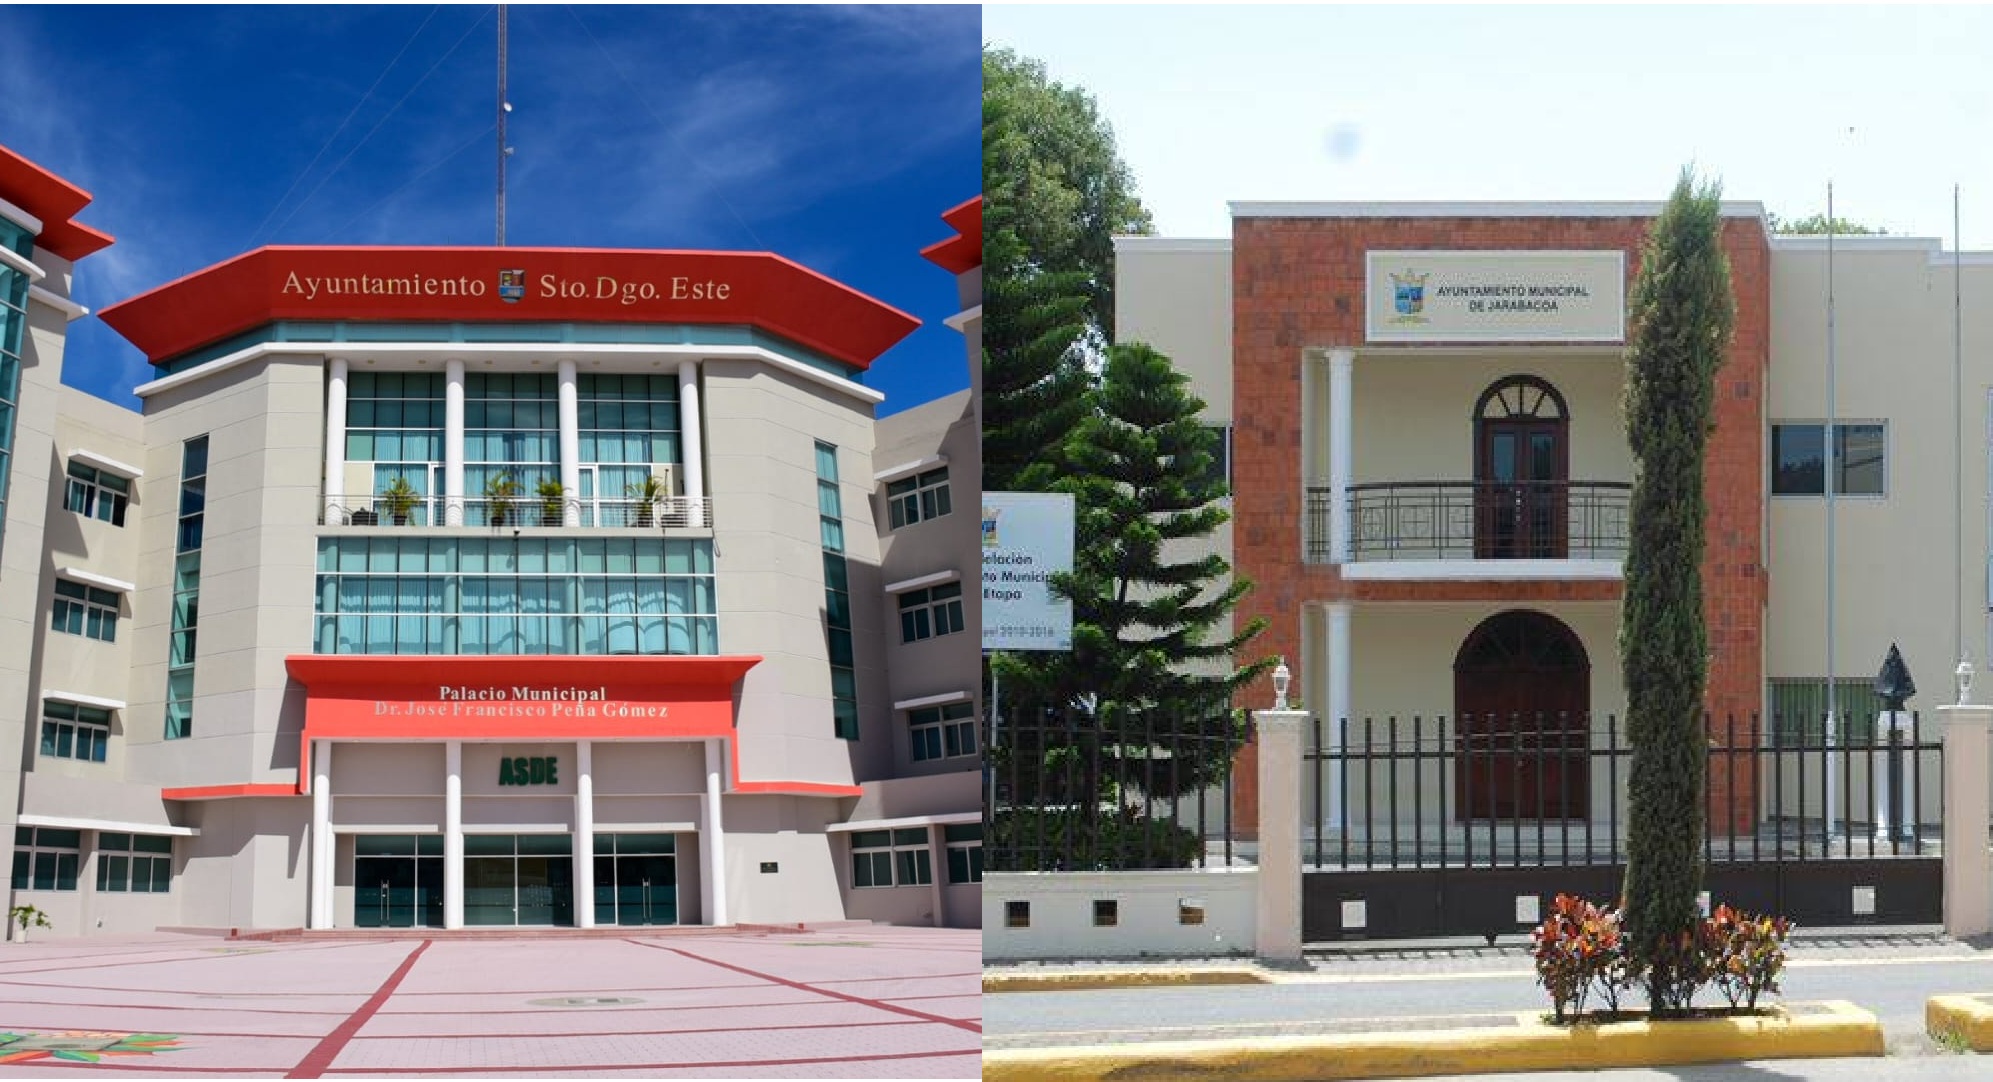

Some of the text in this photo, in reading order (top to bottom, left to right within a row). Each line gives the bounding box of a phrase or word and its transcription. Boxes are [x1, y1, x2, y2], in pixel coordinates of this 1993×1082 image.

[281, 270, 731, 305] Ayuntamiento Sto. Dgo. Este
[1437, 286, 1589, 297] AYUNTAMIENTO MUNICIPAL
[1469, 301, 1559, 313] DE JARABACOA
[1001, 570, 1056, 584] Municip
[983, 588, 1022, 601] Etapa
[439, 686, 606, 703] Palacio Municipal
[374, 700, 669, 718] Dr. José Francisco Peña Gómez
[498, 756, 558, 786] ASDE
